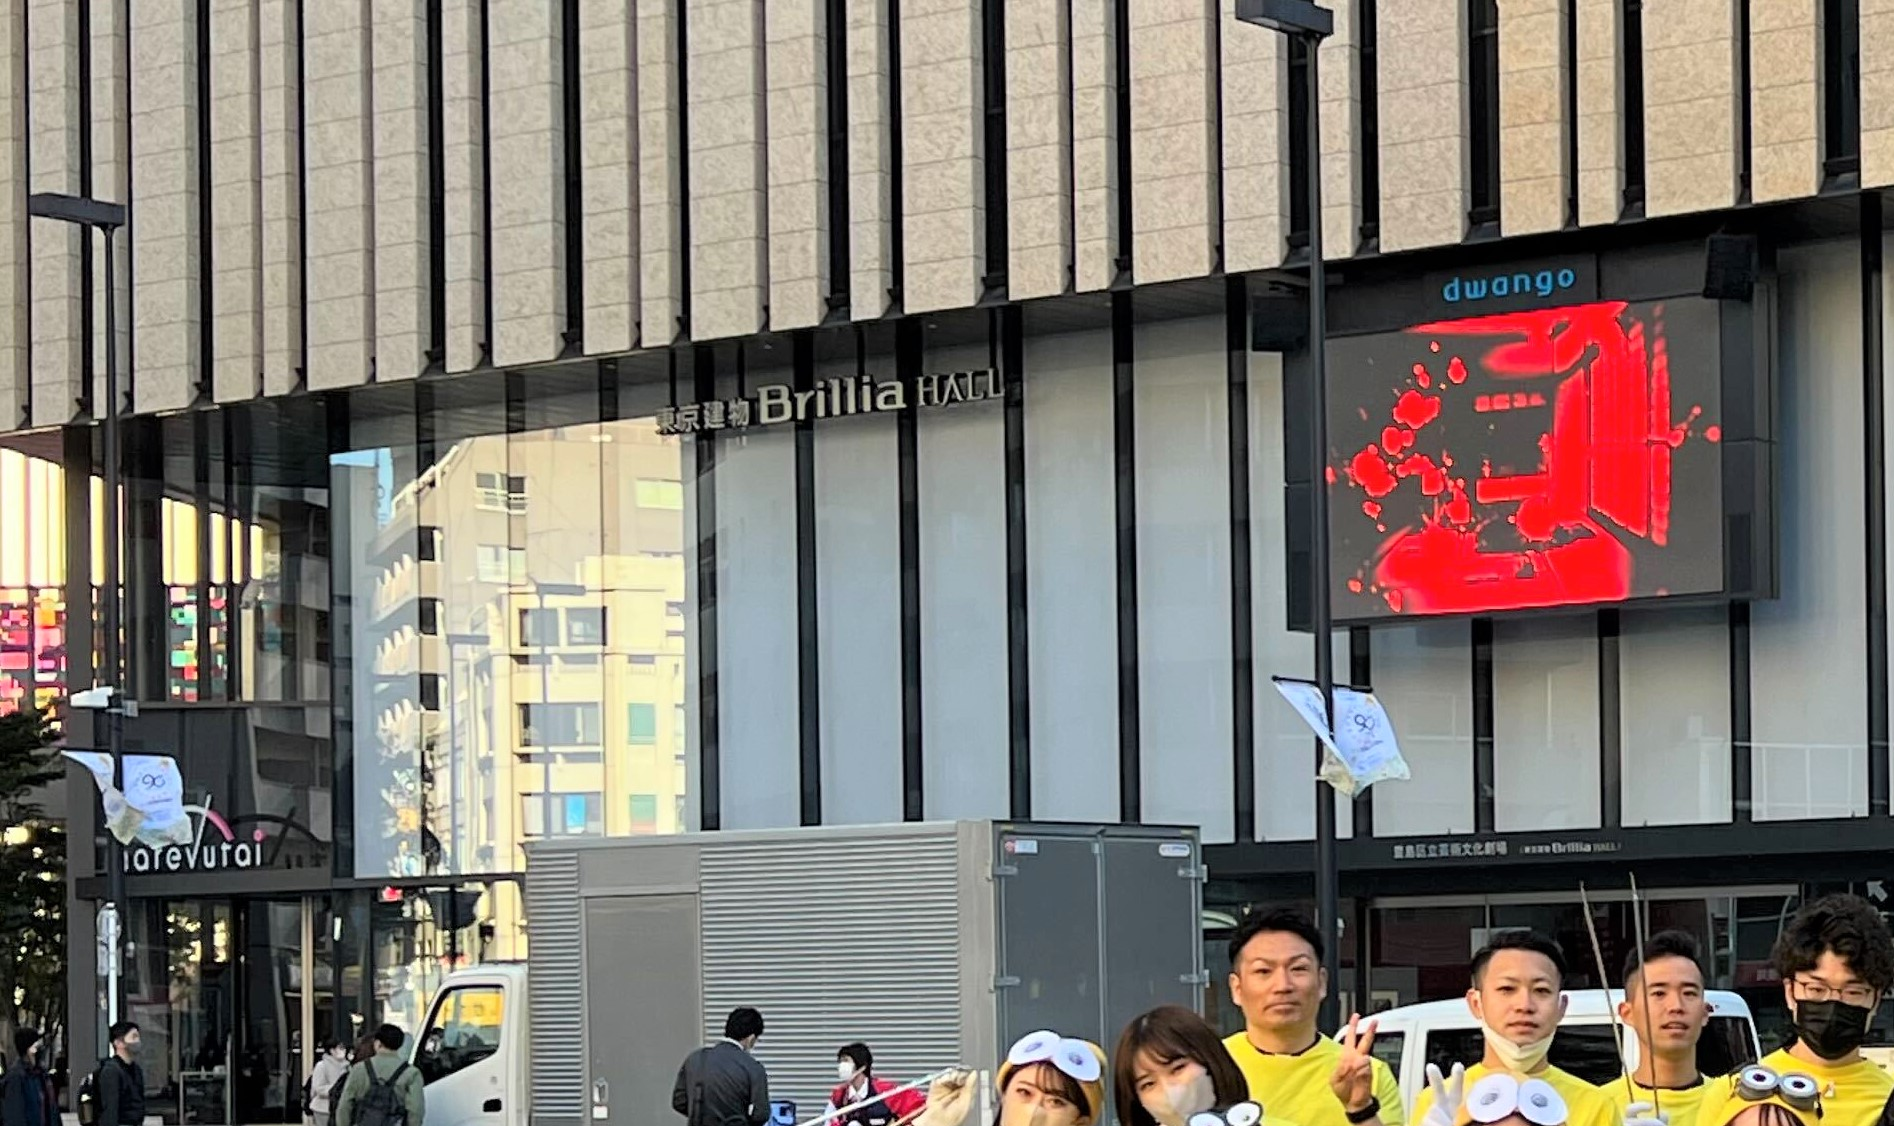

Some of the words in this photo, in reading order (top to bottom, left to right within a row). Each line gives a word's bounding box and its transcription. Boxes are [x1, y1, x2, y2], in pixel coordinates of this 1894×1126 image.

[1443, 268, 1576, 302] dwango
[655, 397, 750, 434] 東京建物
[756, 374, 906, 425] Brillia
[917, 368, 1006, 407] HALL
